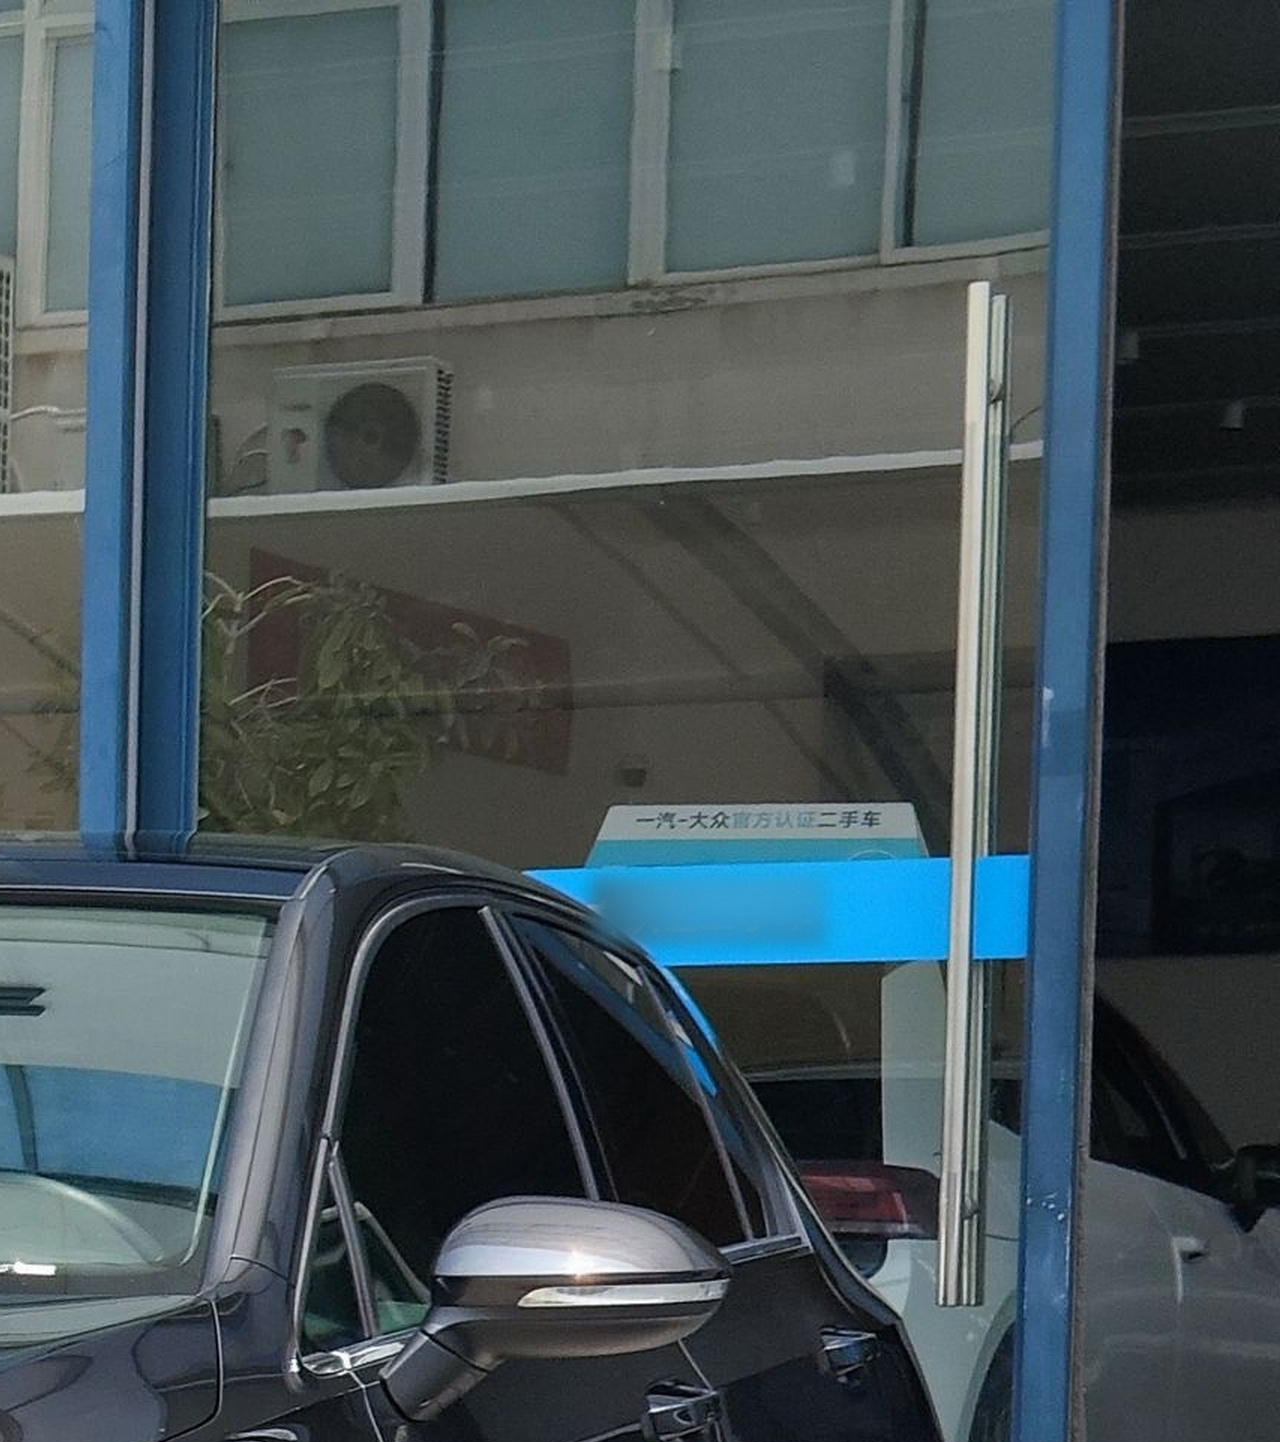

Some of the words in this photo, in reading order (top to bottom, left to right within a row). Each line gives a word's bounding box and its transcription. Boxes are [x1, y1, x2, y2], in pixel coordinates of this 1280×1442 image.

[636, 810, 882, 829] 一汽-大众官方认证二手车
